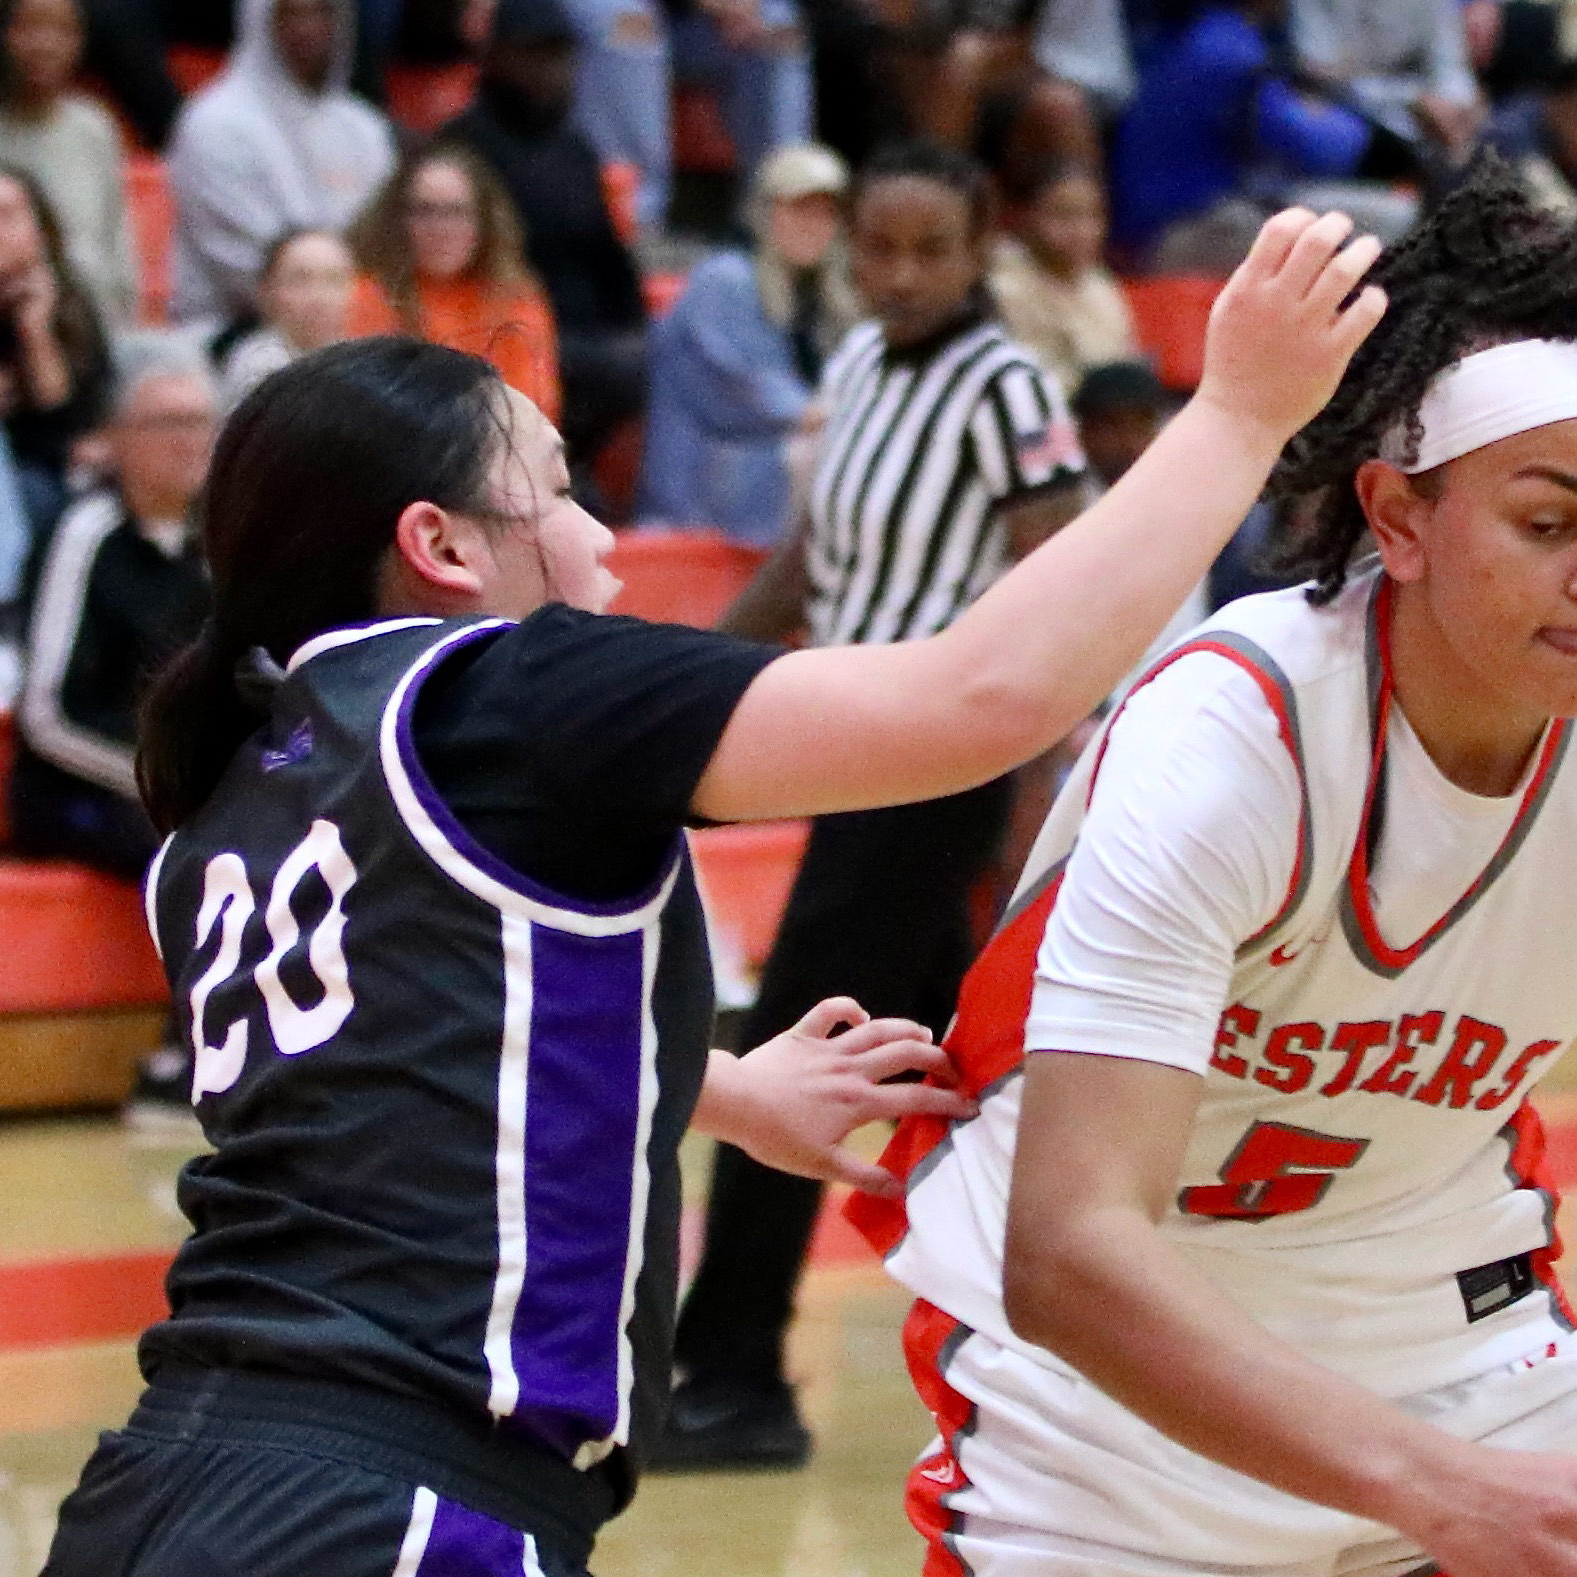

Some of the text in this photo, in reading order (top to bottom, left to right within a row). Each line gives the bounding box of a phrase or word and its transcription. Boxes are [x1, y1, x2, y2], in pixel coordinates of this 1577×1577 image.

[190, 820, 357, 1106] 20
[1209, 1003, 1563, 1110] ESTERS
[1177, 1119, 1372, 1223] 5
